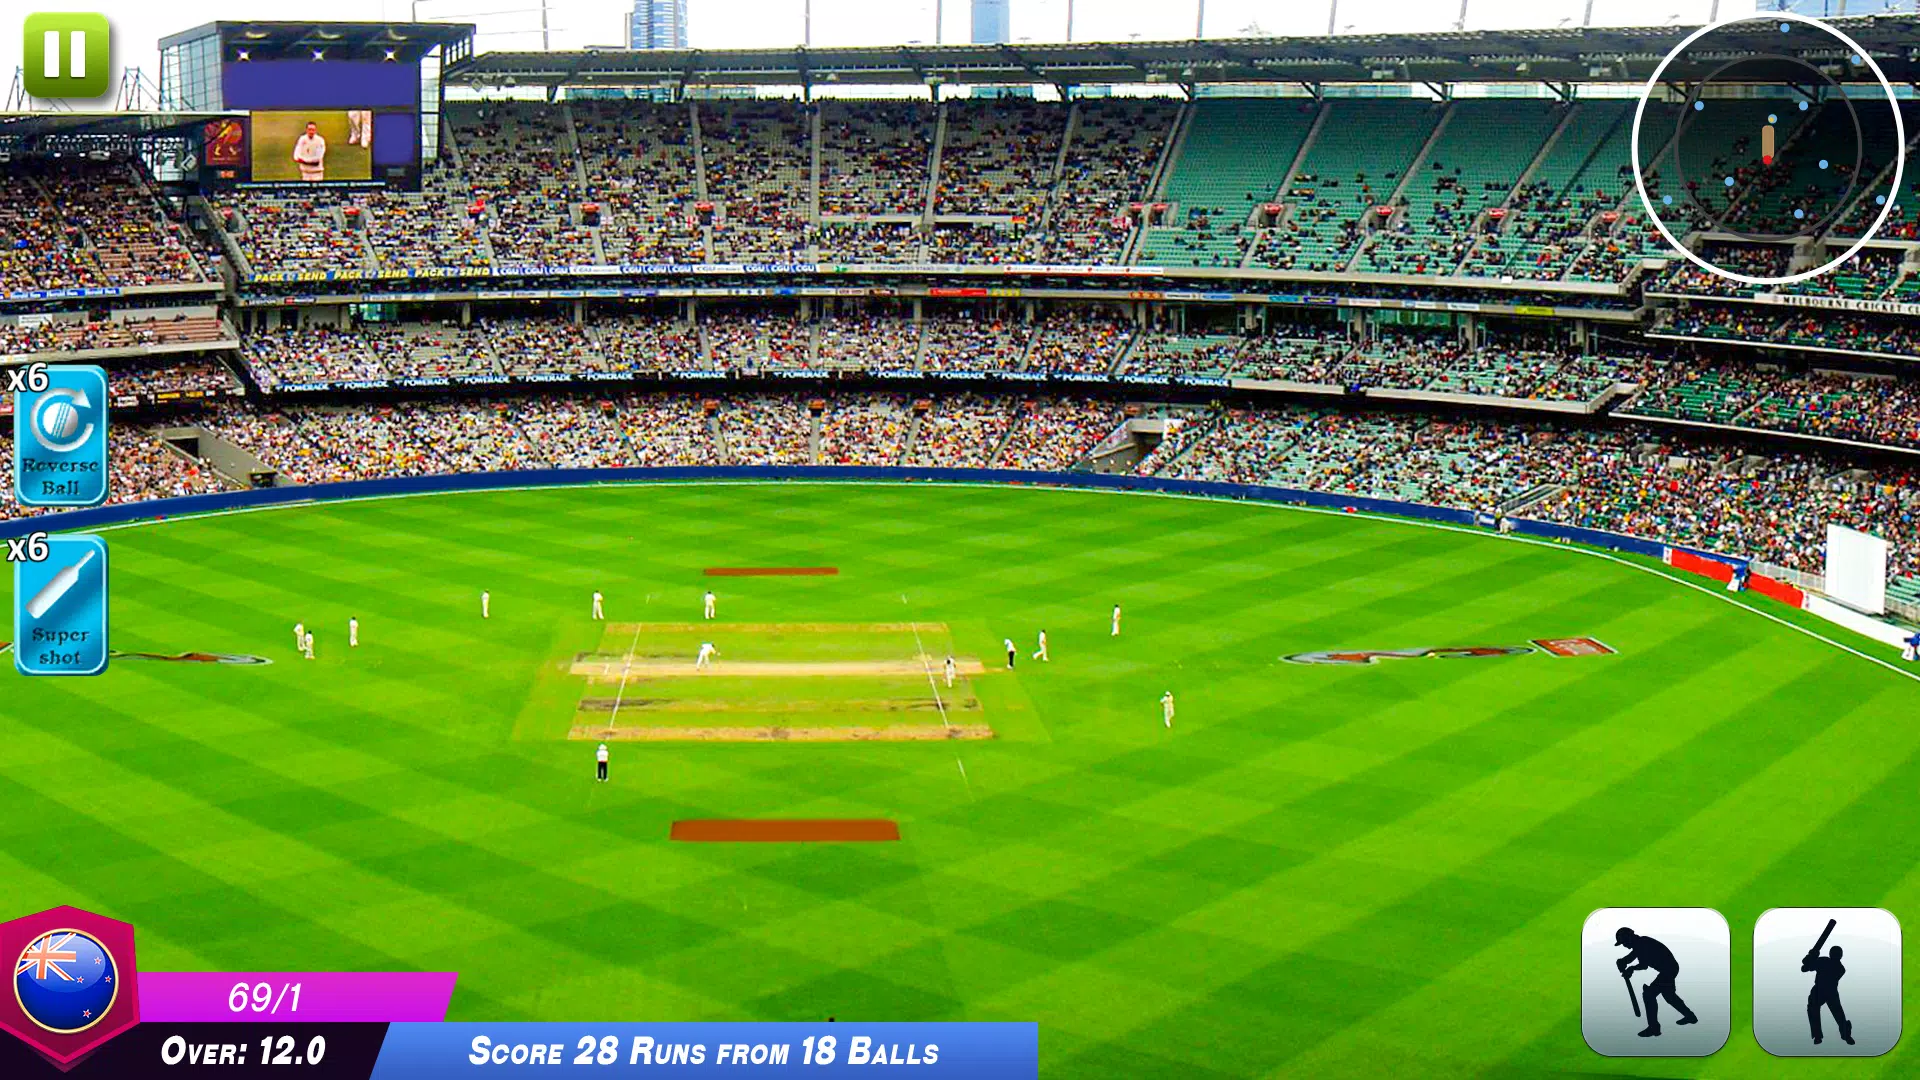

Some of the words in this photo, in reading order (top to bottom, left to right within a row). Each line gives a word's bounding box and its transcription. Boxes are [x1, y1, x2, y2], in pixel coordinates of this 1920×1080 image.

[414, 267, 445, 277] PACK
[459, 267, 490, 277] SEND
[500, 267, 519, 276] CGU
[525, 267, 544, 276] CGU
[622, 265, 642, 274] CGU
[647, 265, 667, 274] CGU
[746, 264, 765, 273] CGU
[771, 264, 790, 273] CGU
[796, 264, 814, 273] CGU
[254, 273, 284, 282] PACK
[297, 271, 327, 281] SEND
[333, 270, 363, 280] PACK
[377, 268, 408, 278] SEND
[1783, 296, 1849, 309] MELBOURNE
[1856, 301, 1901, 312] CRICKET
[525, 373, 572, 382] POWERADE
[587, 372, 634, 381] POWERADE
[680, 370, 727, 379] POWERADE
[783, 370, 830, 379] POWERADE
[877, 370, 924, 379] POWERADE
[939, 370, 986, 379] POWERADE
[1001, 371, 1048, 380] POWERADE
[1063, 373, 1109, 382] POWERADE
[404, 378, 450, 387] POWERADE
[464, 375, 511, 384] POWERADE
[1123, 374, 1170, 385] POWERADE
[1184, 376, 1229, 387] POWERADE
[284, 383, 329, 392] POWERADE
[344, 381, 389, 390] POWERADE
